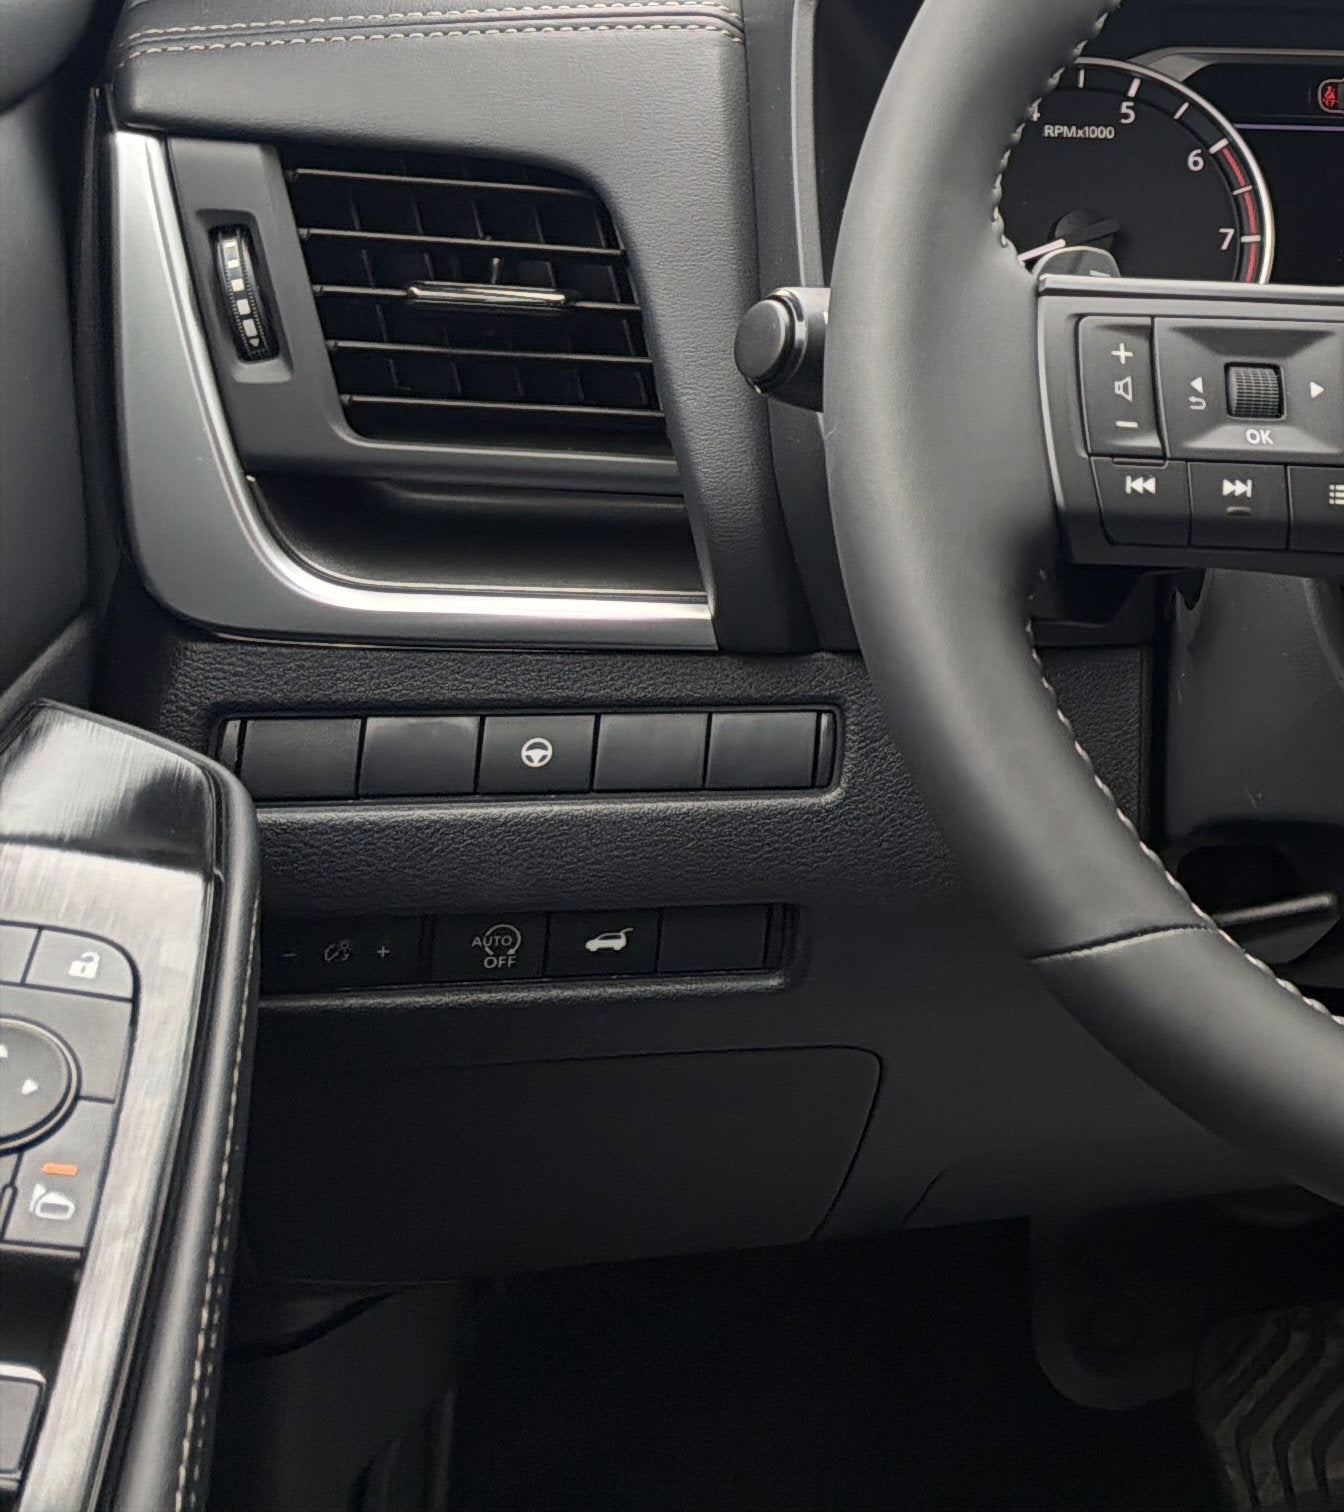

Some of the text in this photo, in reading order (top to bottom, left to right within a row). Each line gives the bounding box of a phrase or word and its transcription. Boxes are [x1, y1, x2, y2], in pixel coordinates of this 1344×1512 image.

[1119, 100, 1136, 124] 5
[1043, 124, 1116, 140] RPMx1000
[1187, 149, 1205, 172] 6
[1218, 227, 1236, 250] 7
[1245, 428, 1274, 445] OK
[472, 935, 512, 948] AUTO
[484, 955, 516, 968] OFF
